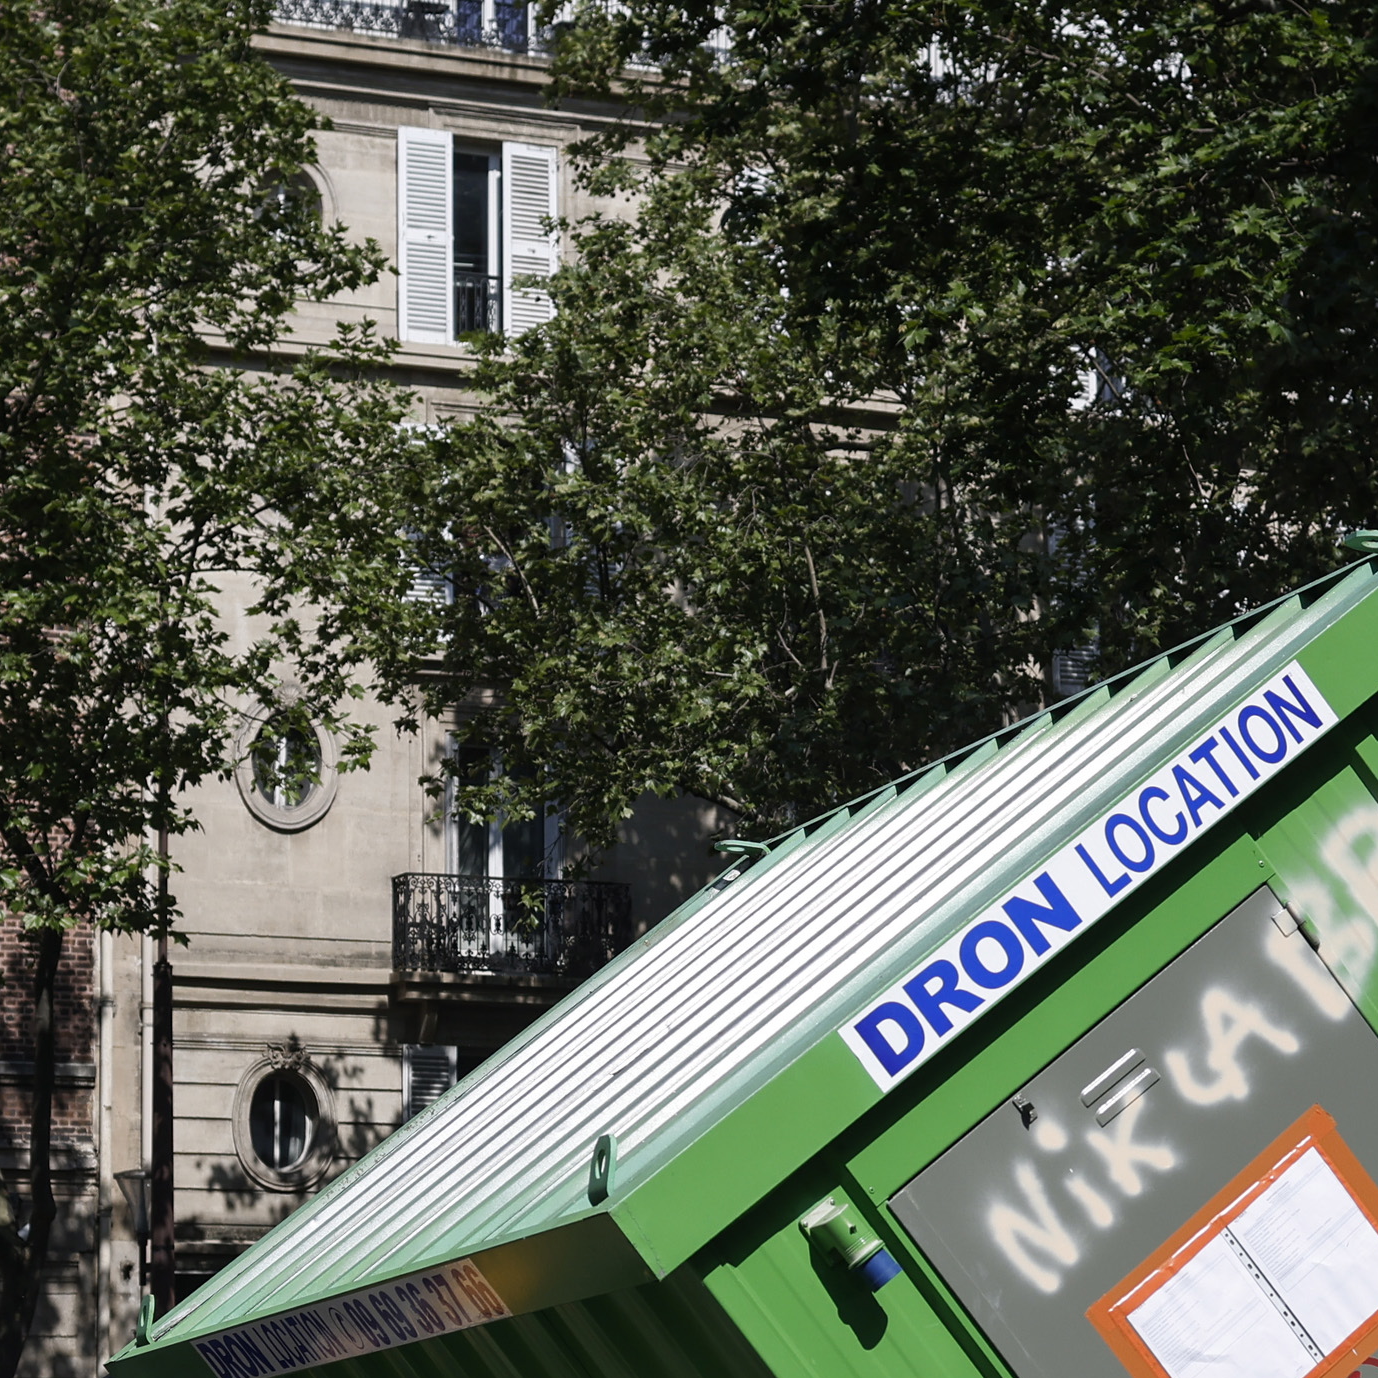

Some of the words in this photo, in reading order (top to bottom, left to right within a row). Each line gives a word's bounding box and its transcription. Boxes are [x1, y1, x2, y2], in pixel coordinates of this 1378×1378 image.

[853, 872, 1084, 1079] DRON
[1075, 674, 1325, 900] LOCATION
[252, 1309, 345, 1370] LOCATION
[342, 1298, 391, 1348] 09
[368, 1290, 419, 1342] 69
[394, 1282, 446, 1335] 36
[422, 1273, 472, 1327] 37
[450, 1264, 506, 1319] 66
